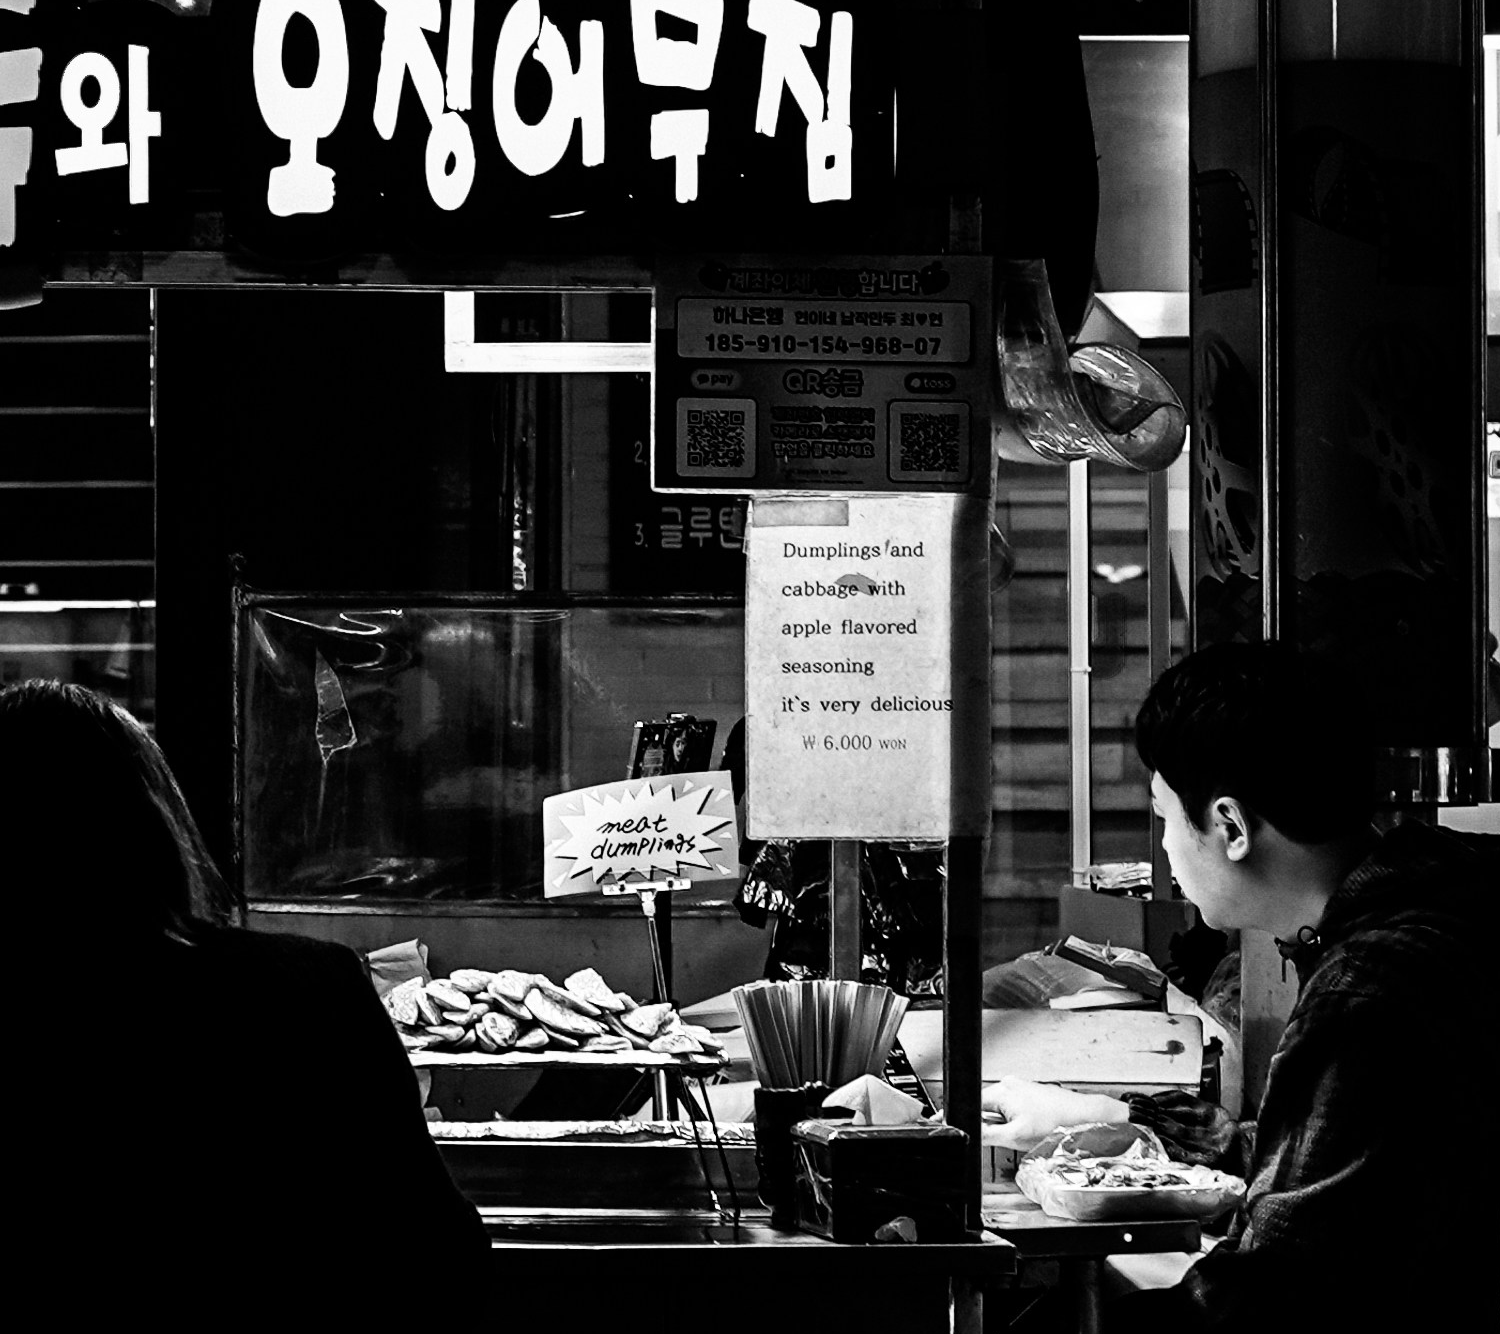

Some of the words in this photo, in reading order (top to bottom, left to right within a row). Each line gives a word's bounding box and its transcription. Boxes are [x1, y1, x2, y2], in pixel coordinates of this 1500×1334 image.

[712, 306, 784, 326] 하나은행
[704, 333, 942, 356] 185-910-154-968-07
[709, 373, 734, 386] pay
[783, 369, 864, 398] QR송금
[922, 377, 951, 389] toss
[782, 541, 882, 560] Dumplings
[889, 541, 925, 558] and
[781, 580, 860, 600] cabbage
[867, 580, 906, 596] with
[781, 619, 832, 638] apple
[840, 618, 918, 635] flavored
[781, 658, 875, 676] seasoning
[819, 698, 861, 715] very
[870, 695, 955, 712] delicious
[878, 738, 908, 750] WON
[596, 813, 669, 836] meat
[590, 832, 697, 860] dumplings
